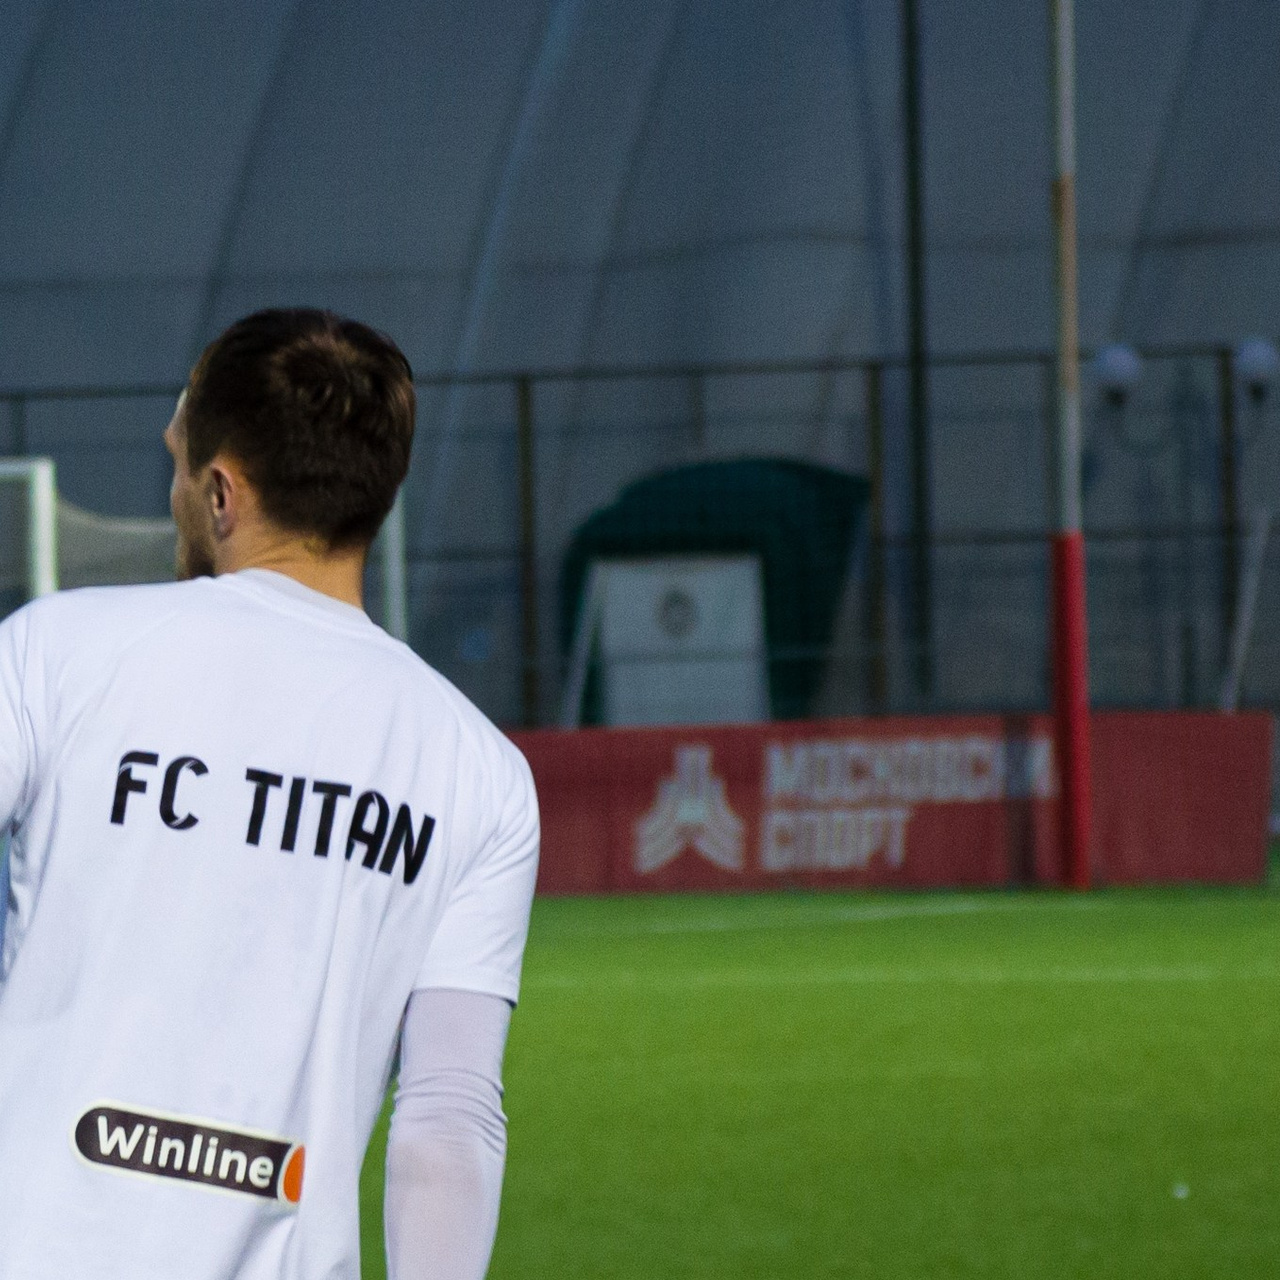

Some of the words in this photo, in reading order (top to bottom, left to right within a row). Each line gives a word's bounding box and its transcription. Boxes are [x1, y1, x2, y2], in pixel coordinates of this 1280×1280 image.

[110, 750, 209, 830] FC
[245, 767, 436, 885] TITAN
[97, 1115, 274, 1189] Winline
